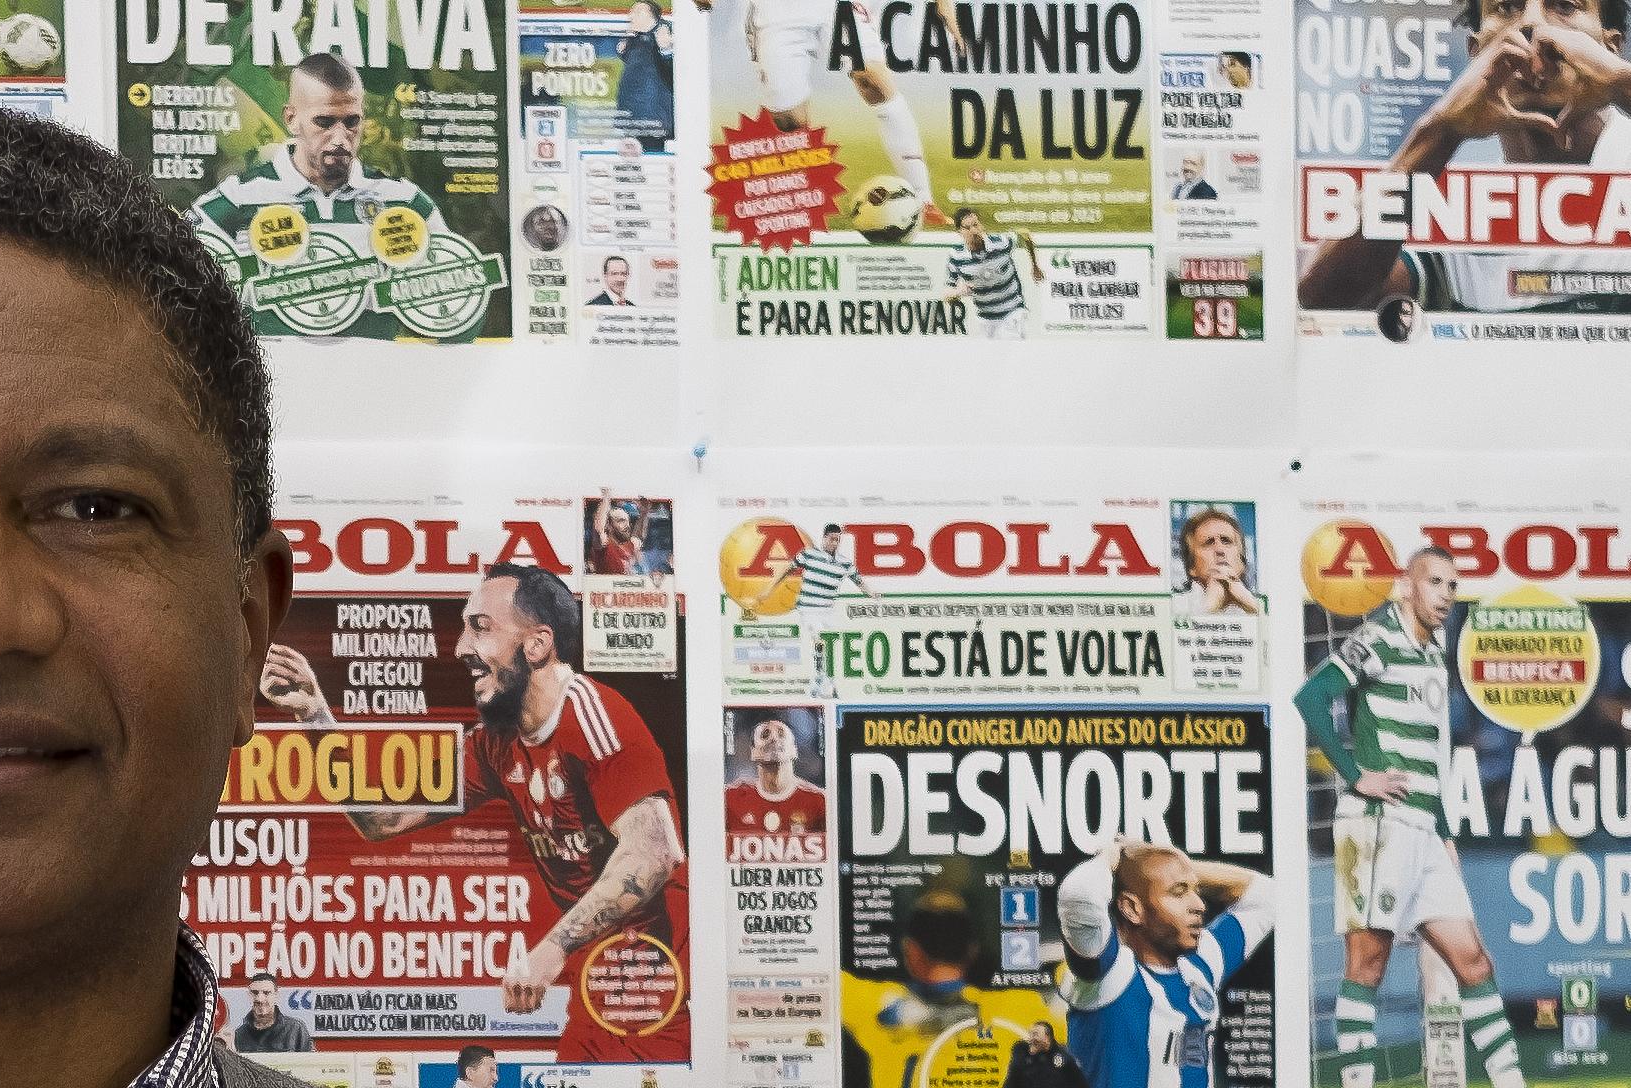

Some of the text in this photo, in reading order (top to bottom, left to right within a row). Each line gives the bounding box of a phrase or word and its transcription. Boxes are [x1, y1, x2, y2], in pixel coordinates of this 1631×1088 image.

[127, 0, 497, 72] DE RAIVA
[546, 43, 595, 68] ZERO
[828, 2, 1141, 74] A CAMINHO
[1299, 17, 1452, 86] QUASE
[532, 71, 609, 97] PONTOS
[952, 89, 1026, 159] DA
[1041, 89, 1145, 159] LUZ
[1299, 90, 1367, 158] NO
[1308, 172, 1631, 244] BENFICA
[737, 257, 839, 290] ADRIEN
[738, 293, 967, 334] É PARA RENOVAR
[273, 519, 572, 574] BOLA
[843, 521, 1160, 577] BOLA
[1320, 526, 1407, 577] A
[338, 604, 432, 629] PROPOSTA
[332, 630, 437, 657] MILIONÁRIA
[821, 631, 890, 678] TEO
[902, 620, 991, 678] ESTÁ
[1001, 631, 1049, 677] DE
[1057, 630, 1165, 678] VOLTA
[349, 662, 422, 686] CHEGOU
[344, 691, 427, 714] DA CHINA
[864, 712, 1246, 745] DRAGÃO CONGELADO ANTES DO CLÁSSICO
[850, 751, 1264, 856] DESNORTE
[1443, 747, 1489, 837] A
[726, 834, 827, 863] JONAS
[198, 866, 530, 922] MILHÕES PARA SER
[777, 868, 822, 886] ANTES
[738, 892, 817, 910] DOS JOGOS
[744, 916, 811, 935] GRANDES
[325, 932, 530, 979] NO BENFICA
